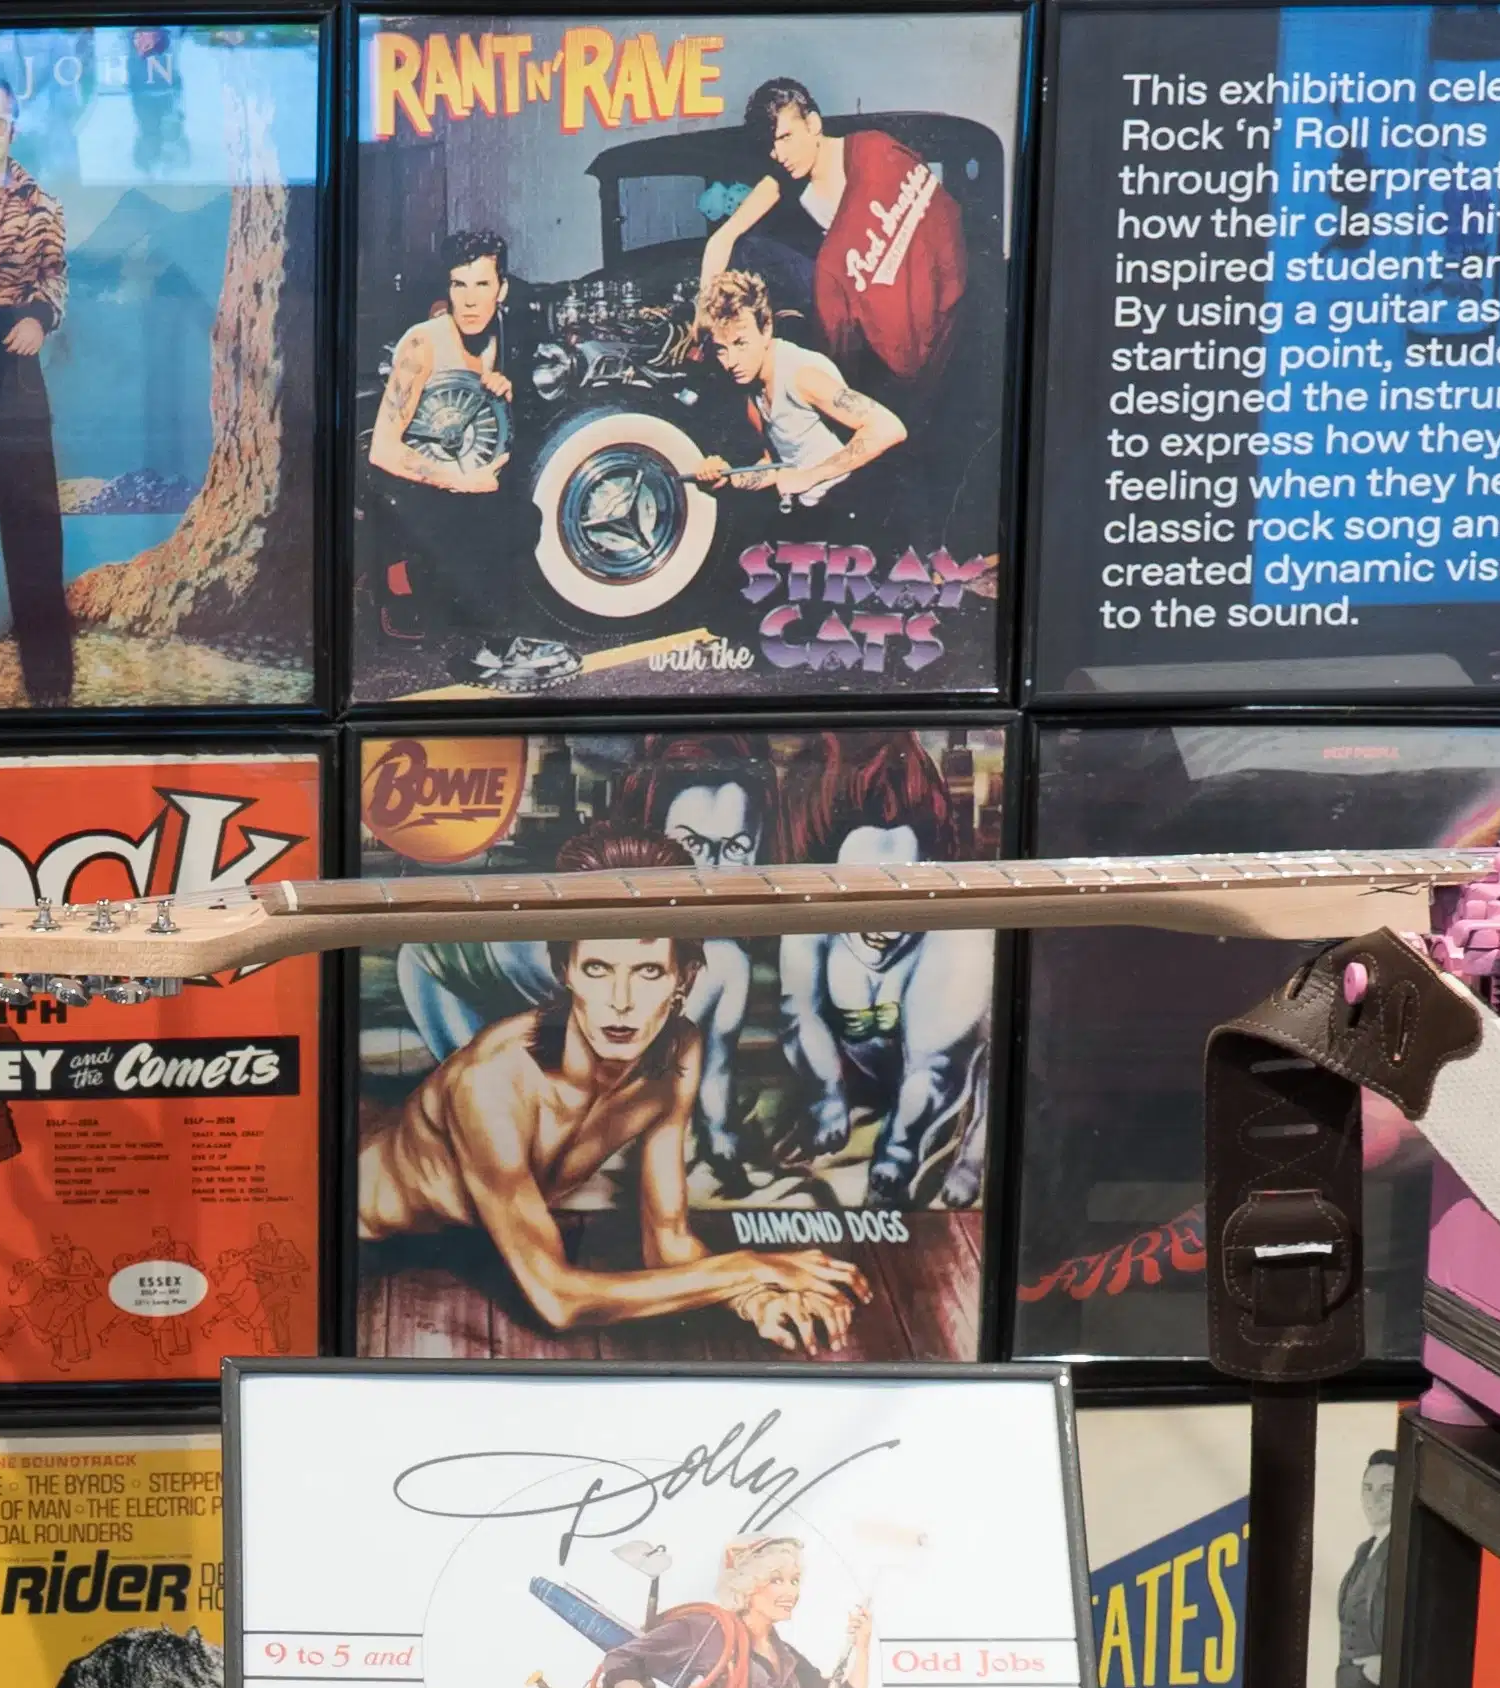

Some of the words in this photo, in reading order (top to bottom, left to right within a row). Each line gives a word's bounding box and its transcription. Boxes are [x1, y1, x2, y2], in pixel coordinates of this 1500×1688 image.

[19, 51, 175, 100] JOHN
[373, 31, 533, 139] RANT
[559, 27, 724, 136] RAVE
[1122, 73, 1208, 106] This
[1219, 71, 1417, 105] exhibition
[1122, 118, 1224, 151] Rock
[1295, 116, 1369, 149] Roll
[1381, 116, 1487, 148] icons
[1118, 162, 1279, 203] through
[1117, 207, 1202, 239] how
[1210, 206, 1306, 238] their
[1314, 204, 1449, 237] classic
[1115, 250, 1275, 291] inspired
[1114, 295, 1167, 335] By
[1177, 294, 1283, 334] using
[1294, 301, 1317, 325] a
[1328, 292, 1448, 333] guitar
[1457, 298, 1500, 323] as
[1111, 338, 1267, 379] starting
[1279, 337, 1393, 377] point,
[1109, 381, 1292, 422] designed
[1302, 381, 1369, 412] the
[1106, 428, 1149, 458] to
[1160, 431, 1314, 464] express
[1326, 423, 1410, 455] how
[1104, 469, 1238, 508] feeling
[1248, 467, 1356, 499] when
[1366, 466, 1456, 504] they
[1103, 511, 1235, 544] classic
[1247, 510, 1334, 542] rock
[1344, 515, 1441, 548] song
[738, 541, 982, 608] STRAY
[647, 641, 709, 672] with
[711, 637, 755, 672] the
[760, 604, 945, 672] CATS
[68, 1066, 104, 1088] the
[69, 1046, 113, 1067] and
[114, 1043, 280, 1091] Comets
[732, 1210, 842, 1244] DIAMOND
[848, 1209, 909, 1244] DOGS
[263, 1642, 287, 1669] 9
[296, 1643, 326, 1668] to
[332, 1642, 351, 1669] 5
[364, 1643, 414, 1668] and
[891, 1647, 964, 1674] Odd
[976, 1647, 1046, 1678] Jobs
